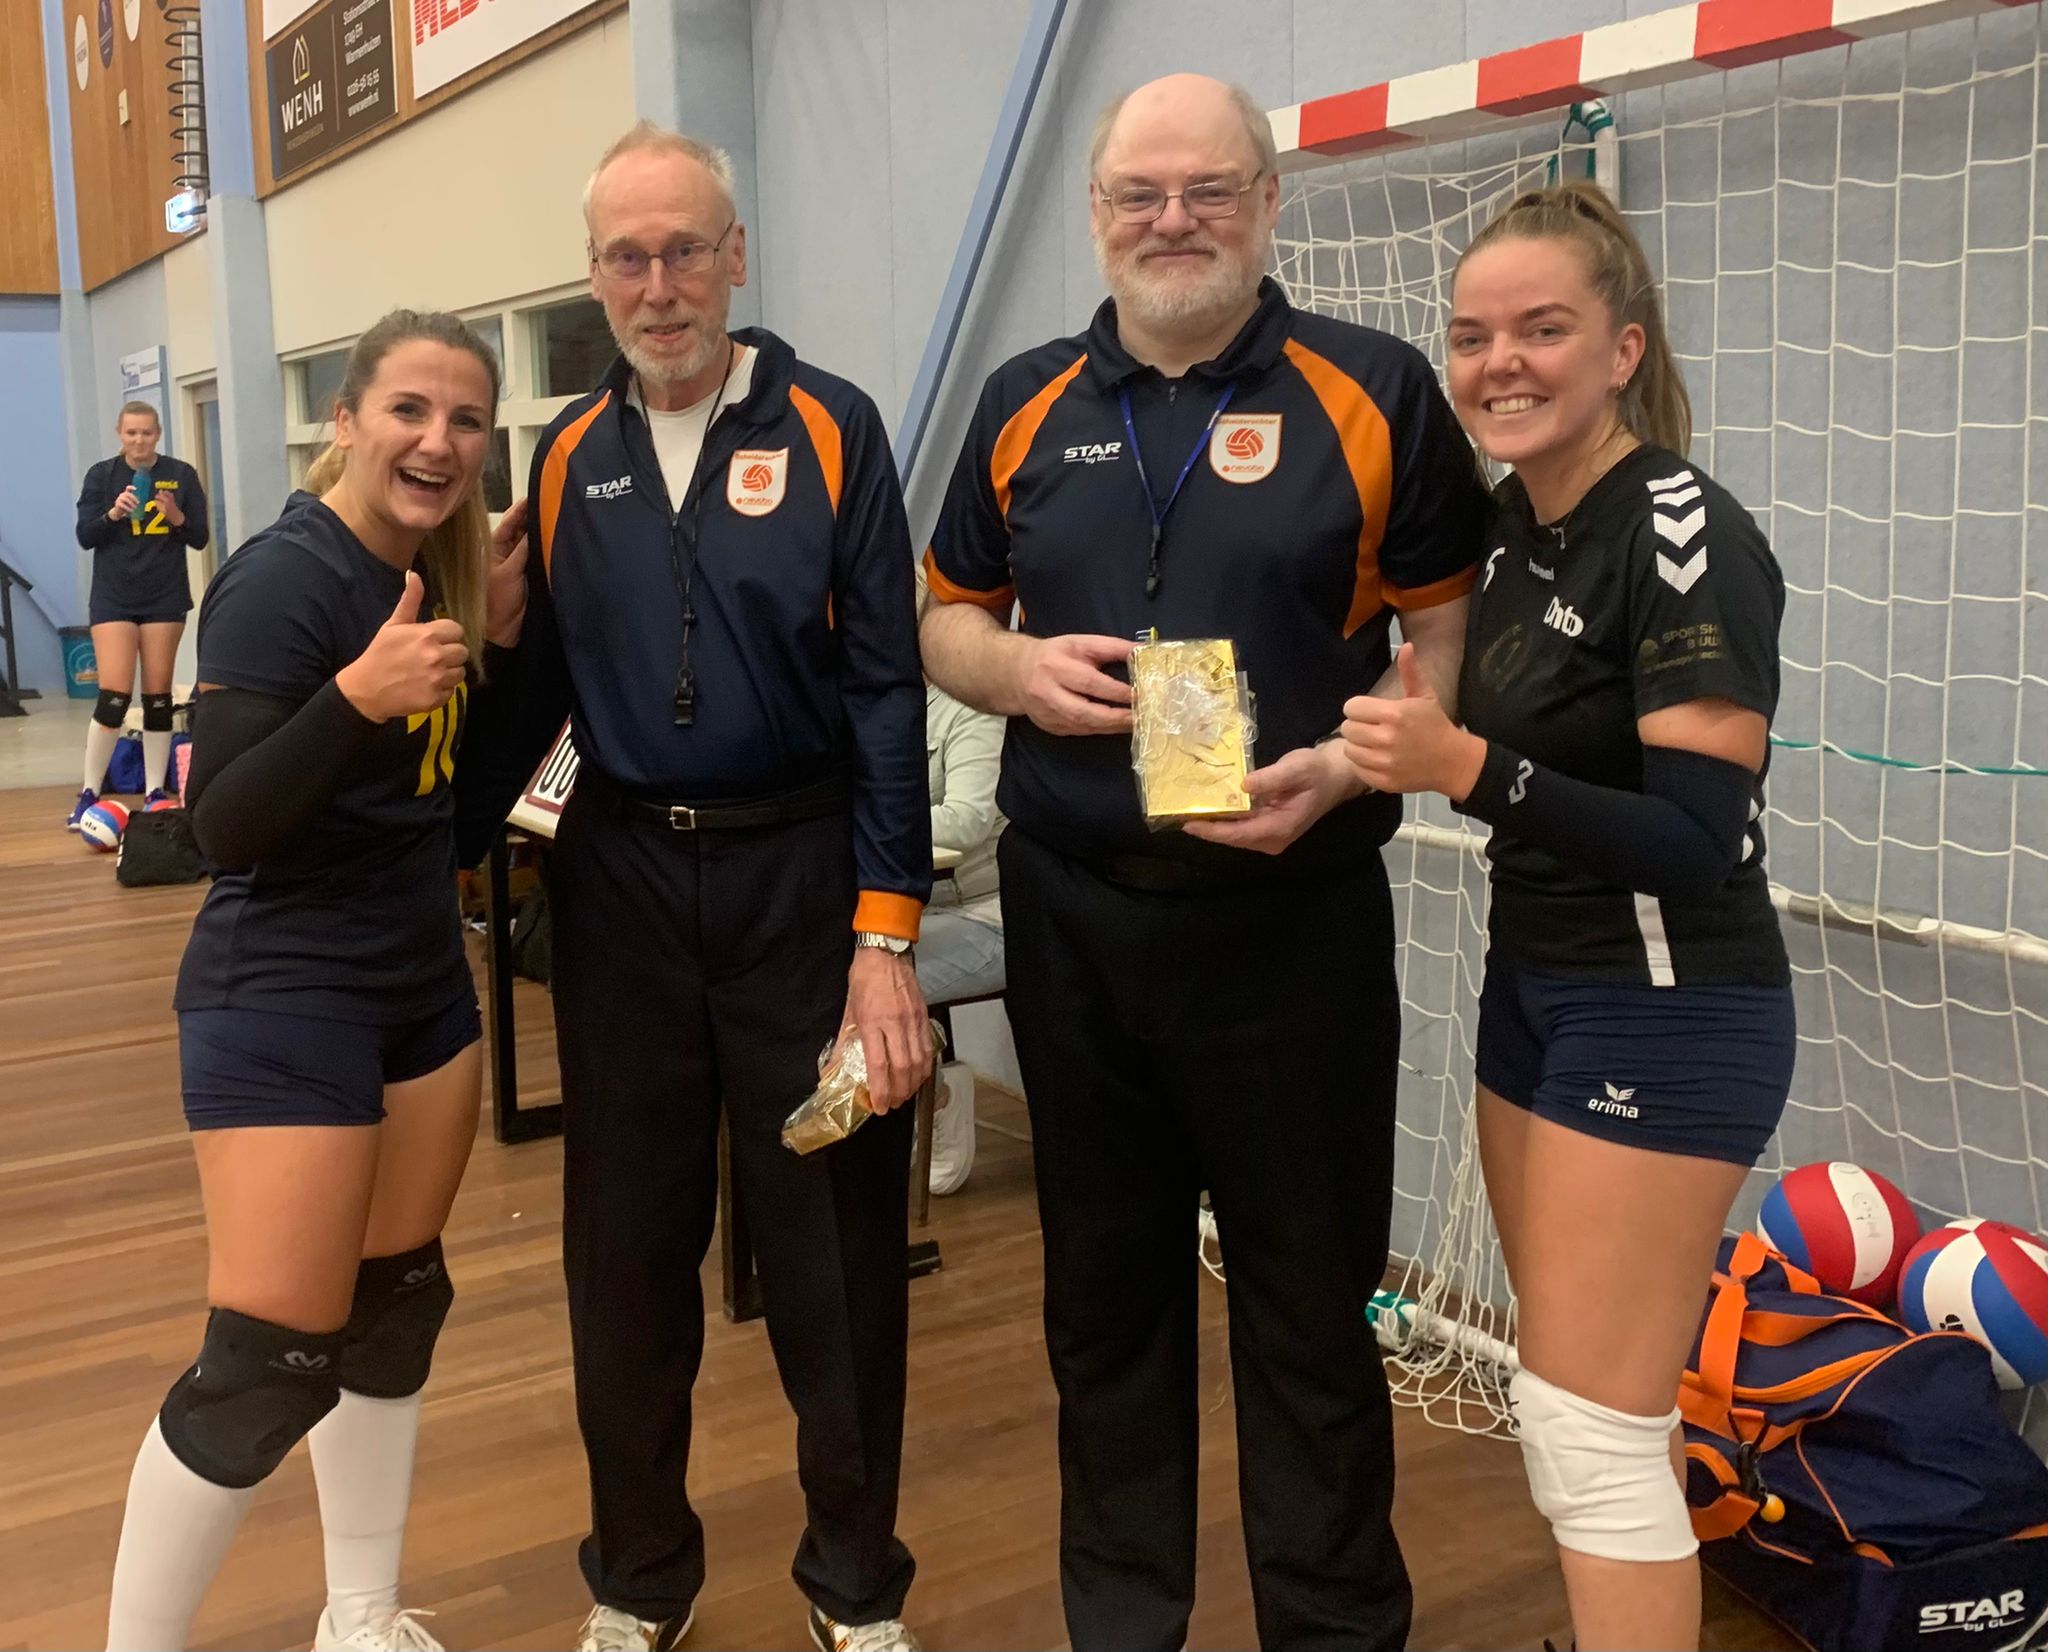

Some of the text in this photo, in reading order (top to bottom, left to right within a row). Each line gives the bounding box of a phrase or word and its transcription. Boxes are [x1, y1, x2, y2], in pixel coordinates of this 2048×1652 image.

[281, 80, 323, 133] WENH
[1064, 442, 1122, 460] STAR
[586, 475, 632, 495] STAR
[1587, 1098, 1639, 1119] erima
[1920, 1589, 2025, 1627] STAR
[1963, 1623, 1985, 1633] by
